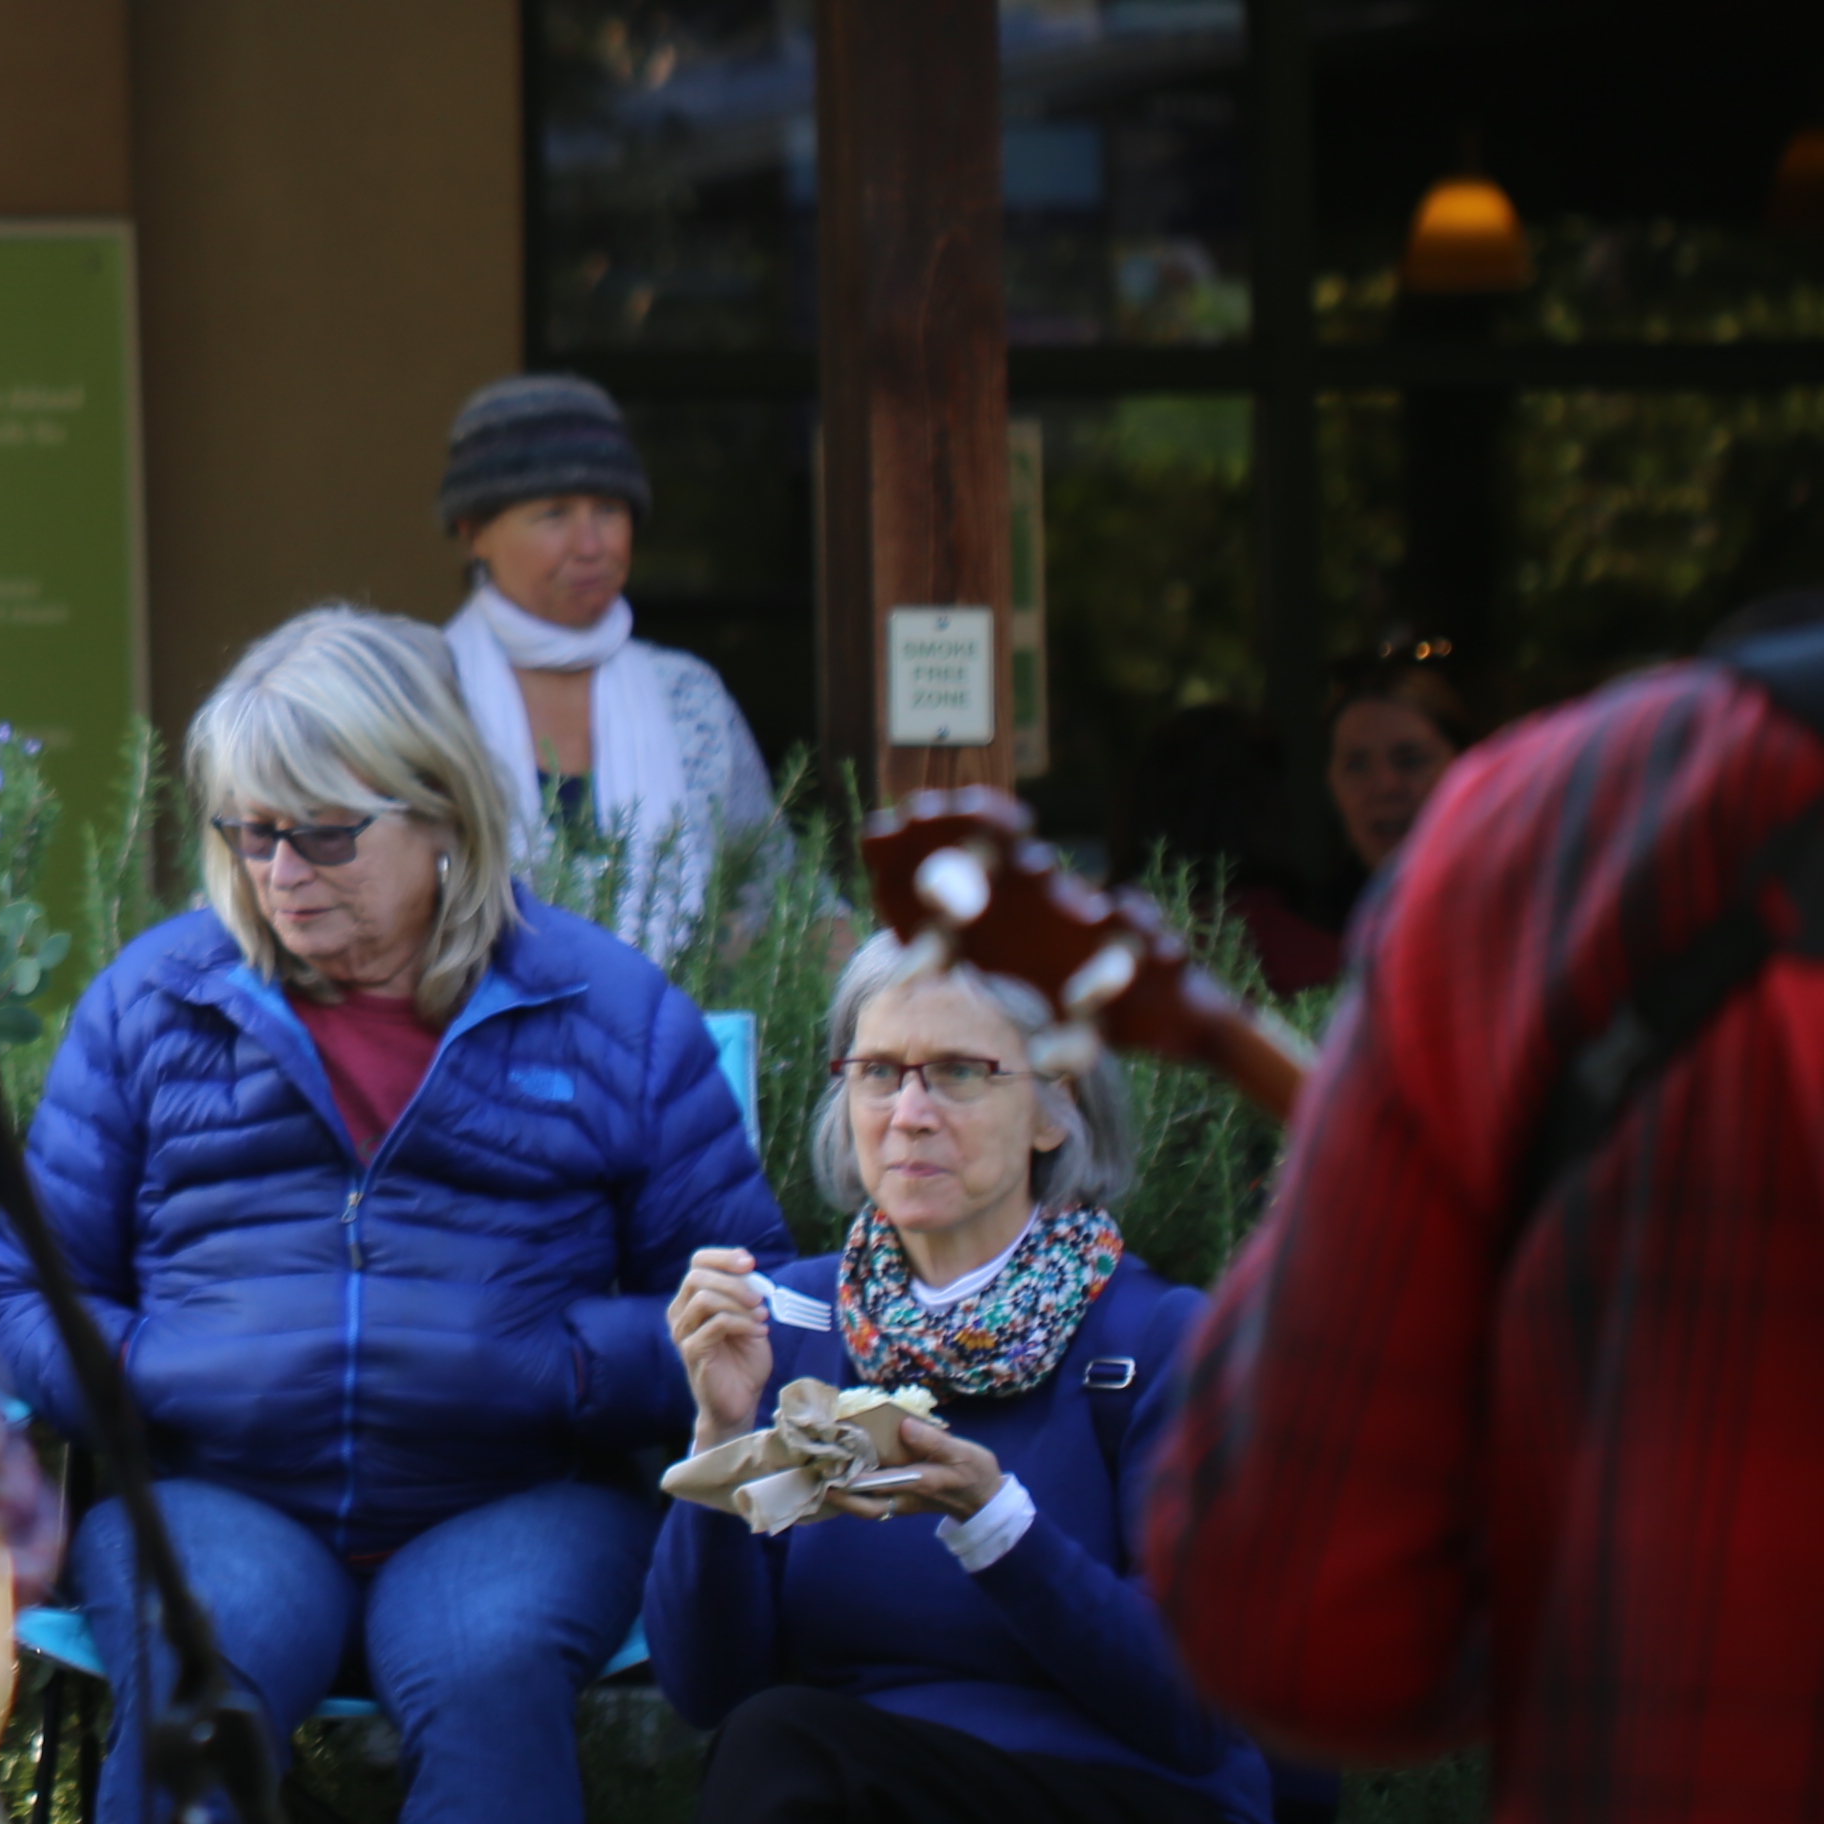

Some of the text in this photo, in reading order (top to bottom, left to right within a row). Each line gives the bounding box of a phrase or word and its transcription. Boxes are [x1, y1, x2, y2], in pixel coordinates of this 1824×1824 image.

[903, 640, 980, 661] SMOKE
[913, 665, 969, 684] FREE
[911, 689, 971, 710] ZONE
